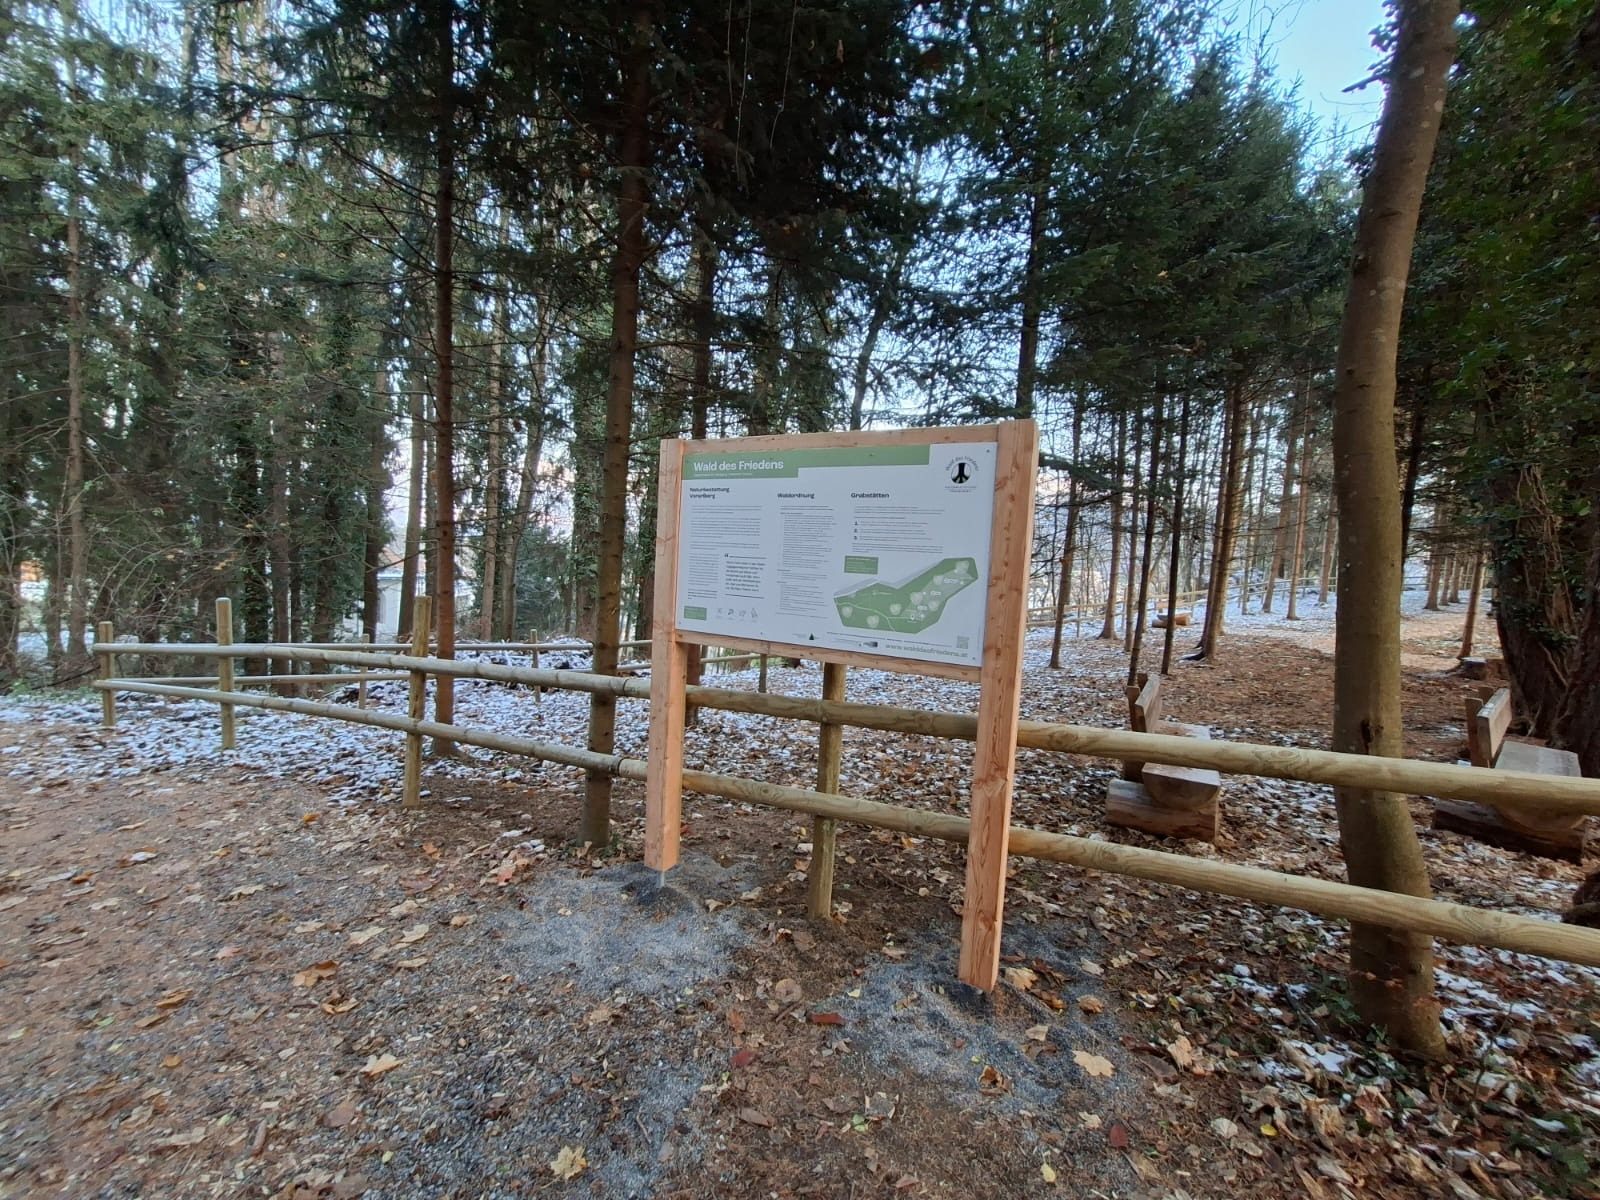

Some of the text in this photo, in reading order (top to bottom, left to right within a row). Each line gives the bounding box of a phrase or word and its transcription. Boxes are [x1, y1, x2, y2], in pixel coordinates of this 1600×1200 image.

[694, 459, 784, 472] Wald des Friedens
